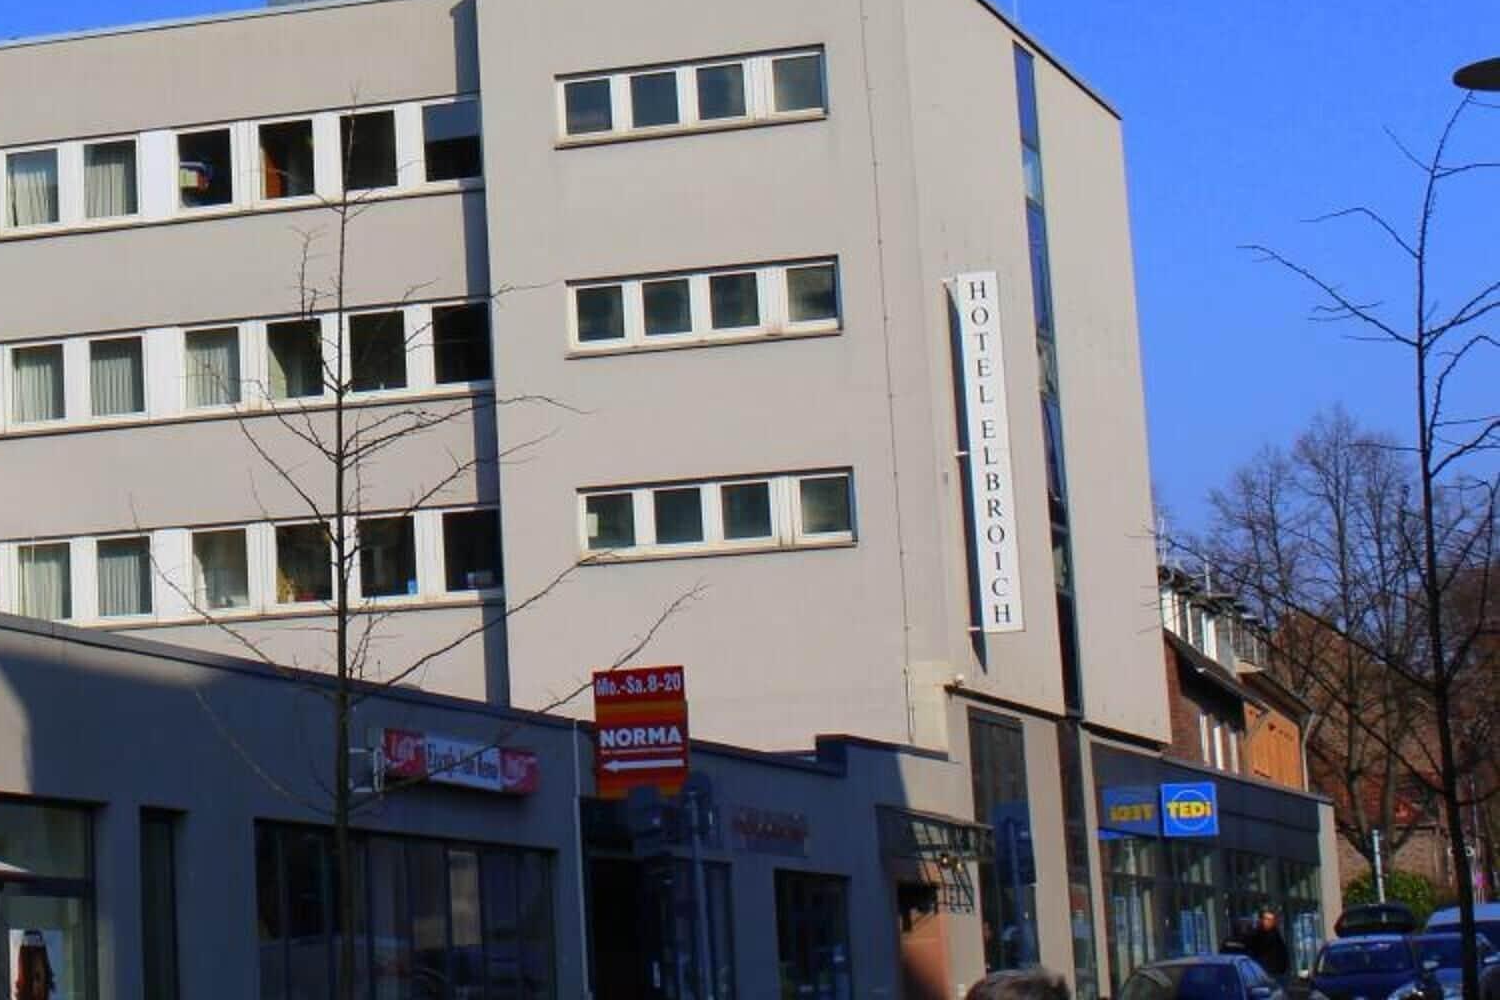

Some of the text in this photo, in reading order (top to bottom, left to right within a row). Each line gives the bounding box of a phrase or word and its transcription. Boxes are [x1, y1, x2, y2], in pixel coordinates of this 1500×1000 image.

[968, 280, 1012, 624] HOTEL ELBROICH
[599, 726, 682, 747] NORMA
